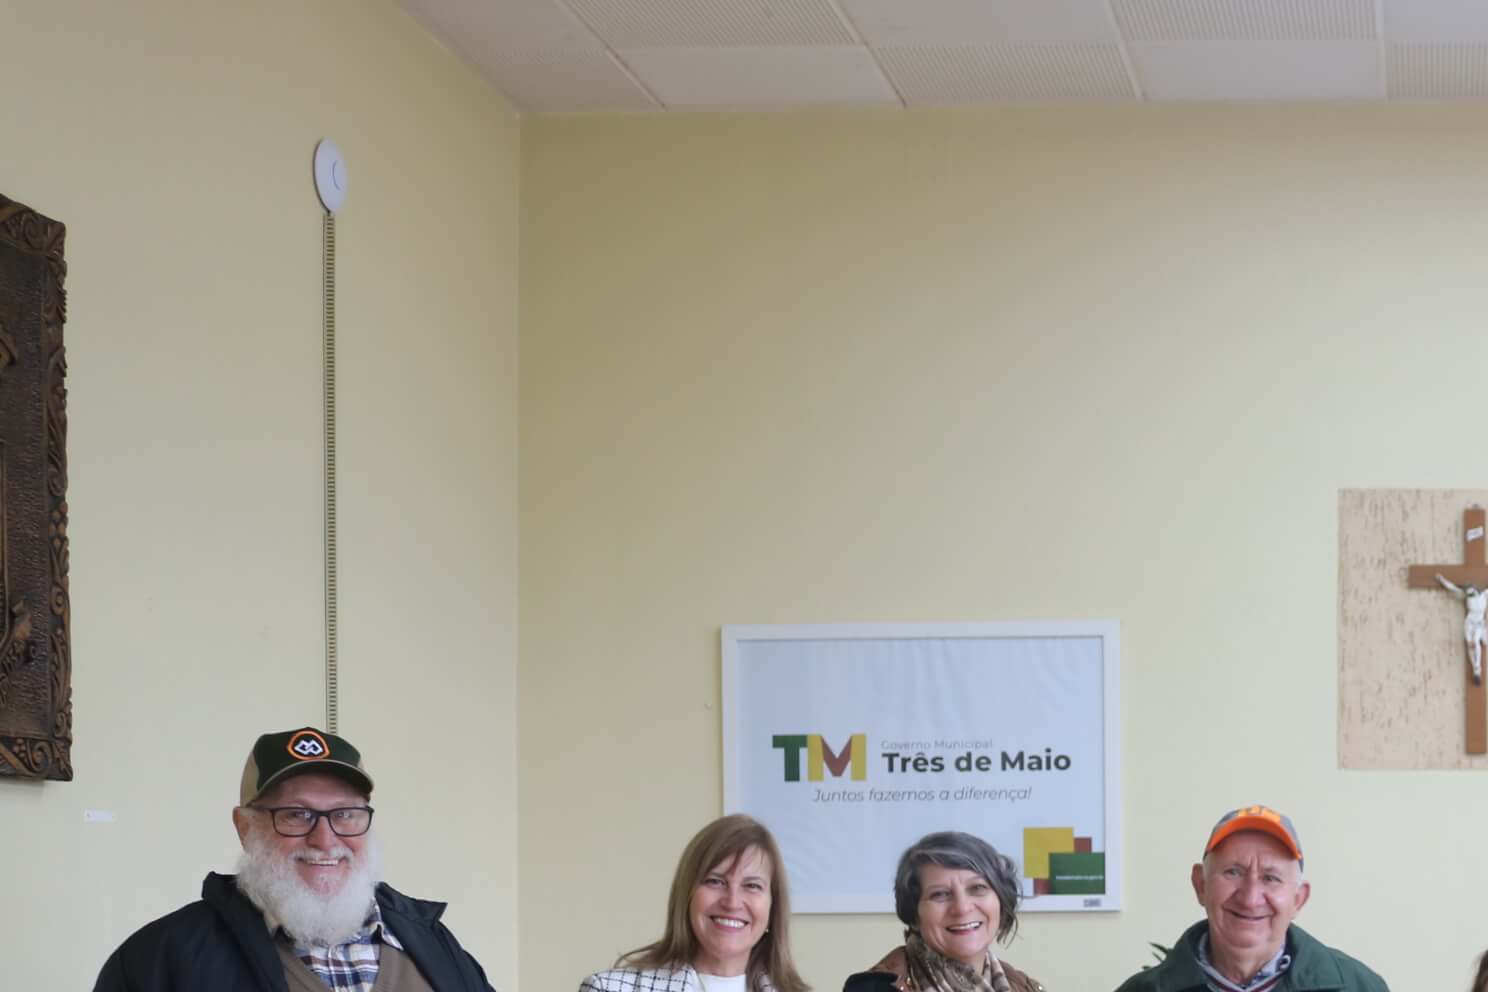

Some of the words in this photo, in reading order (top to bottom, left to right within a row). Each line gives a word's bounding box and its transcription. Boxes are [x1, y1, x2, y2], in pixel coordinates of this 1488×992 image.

[881, 740, 931, 750] Governo
[934, 738, 993, 751] Municipal
[772, 733, 867, 782] TM
[881, 751, 945, 773] Três
[954, 751, 993, 773] de
[1000, 747, 1072, 772] Maio
[812, 788, 865, 803] Juntos
[868, 786, 935, 802] fazemos
[938, 789, 950, 801] a
[953, 785, 1033, 804] diferença!
